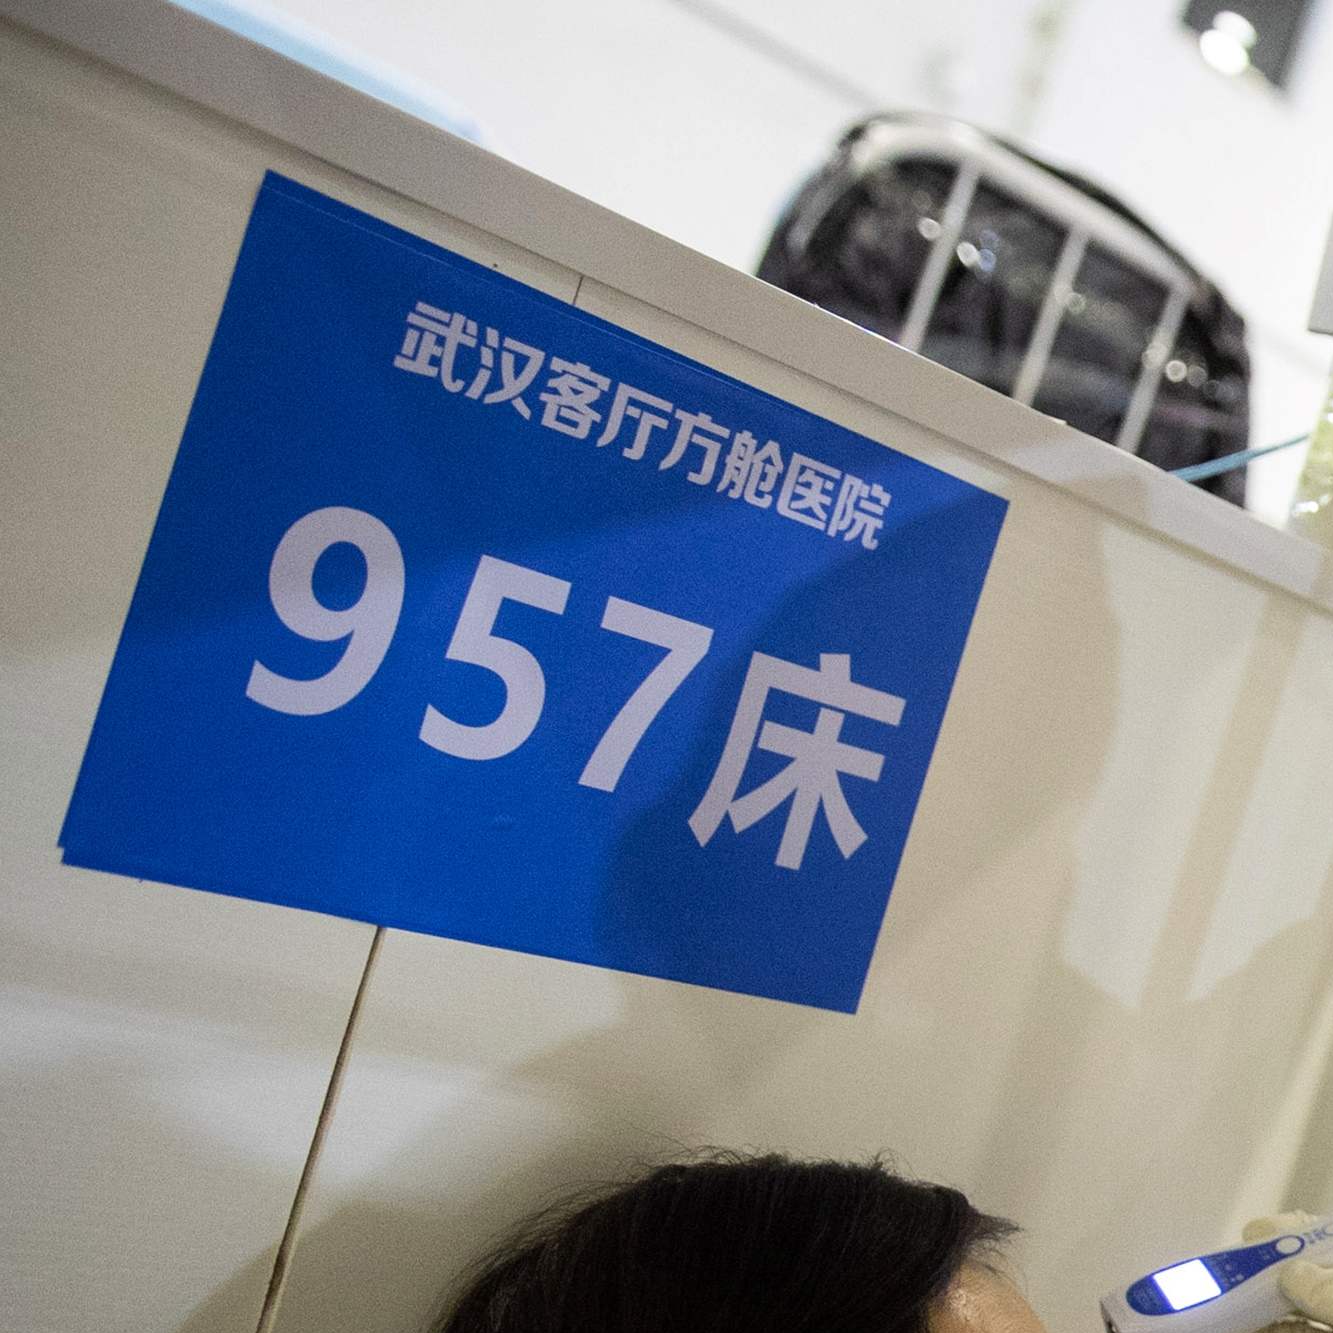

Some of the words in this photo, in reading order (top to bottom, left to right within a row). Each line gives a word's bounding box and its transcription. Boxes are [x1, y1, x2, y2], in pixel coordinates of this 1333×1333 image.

[393, 301, 892, 550] 武汉客厅方舱医院
[245, 506, 908, 870] 957床
